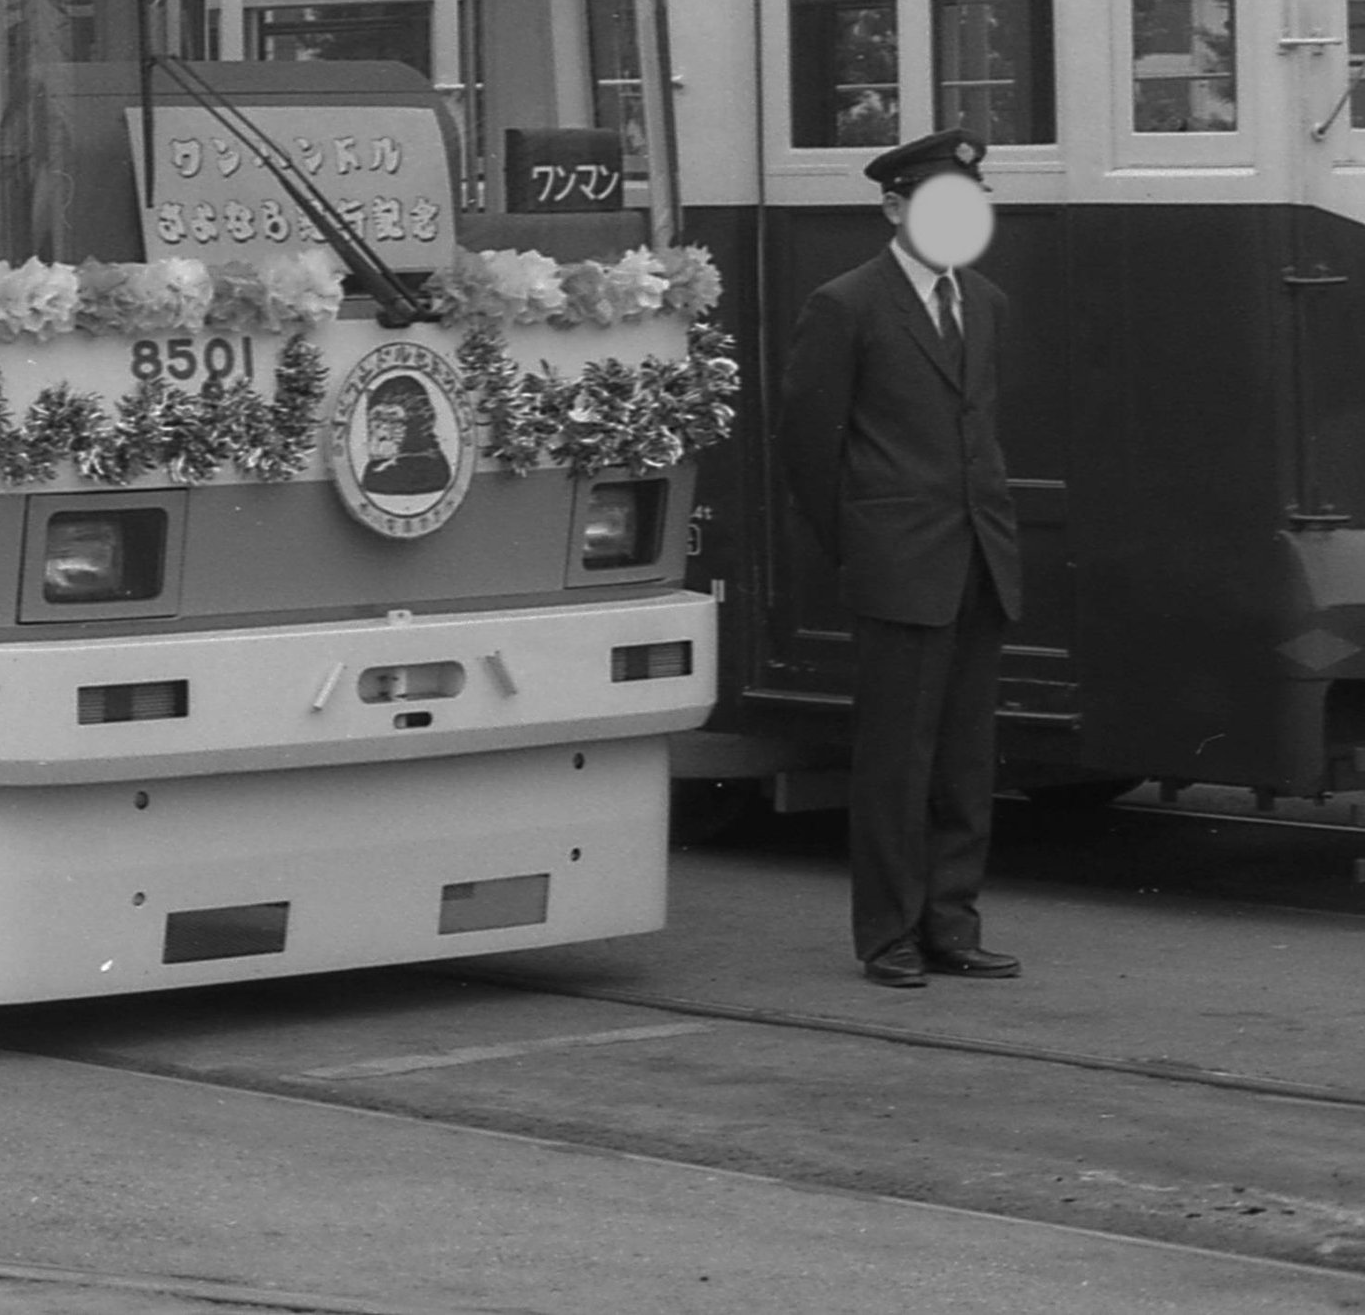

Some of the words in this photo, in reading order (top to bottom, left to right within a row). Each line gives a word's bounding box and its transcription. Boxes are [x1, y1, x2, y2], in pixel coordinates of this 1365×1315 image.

[532, 165, 620, 202] ワンマン
[131, 337, 254, 383] 8501
